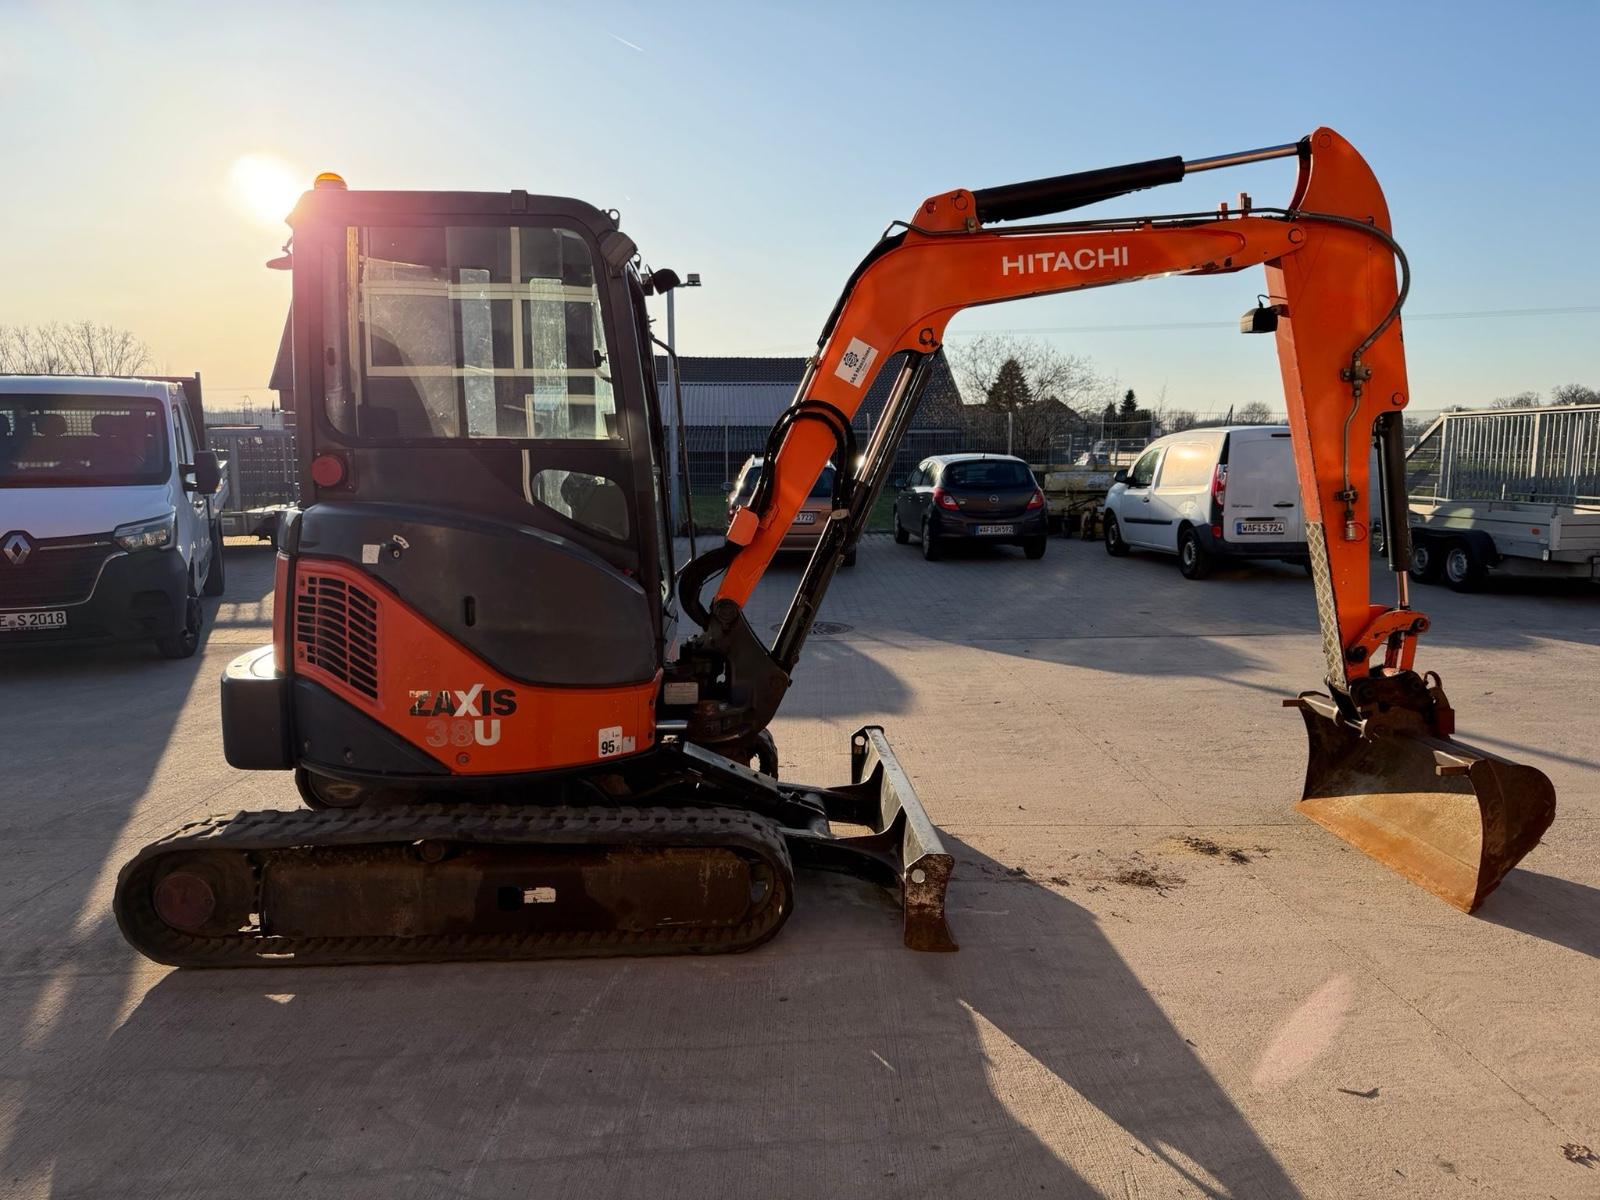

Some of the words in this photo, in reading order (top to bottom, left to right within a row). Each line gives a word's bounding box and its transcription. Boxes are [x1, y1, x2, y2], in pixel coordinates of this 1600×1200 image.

[1002, 246, 1128, 276] HITACHI
[17, 614, 27, 626] S
[29, 612, 65, 625] 2018
[409, 683, 517, 717] ZAXIS
[425, 719, 501, 748] 38U
[601, 740, 615, 755] 95
